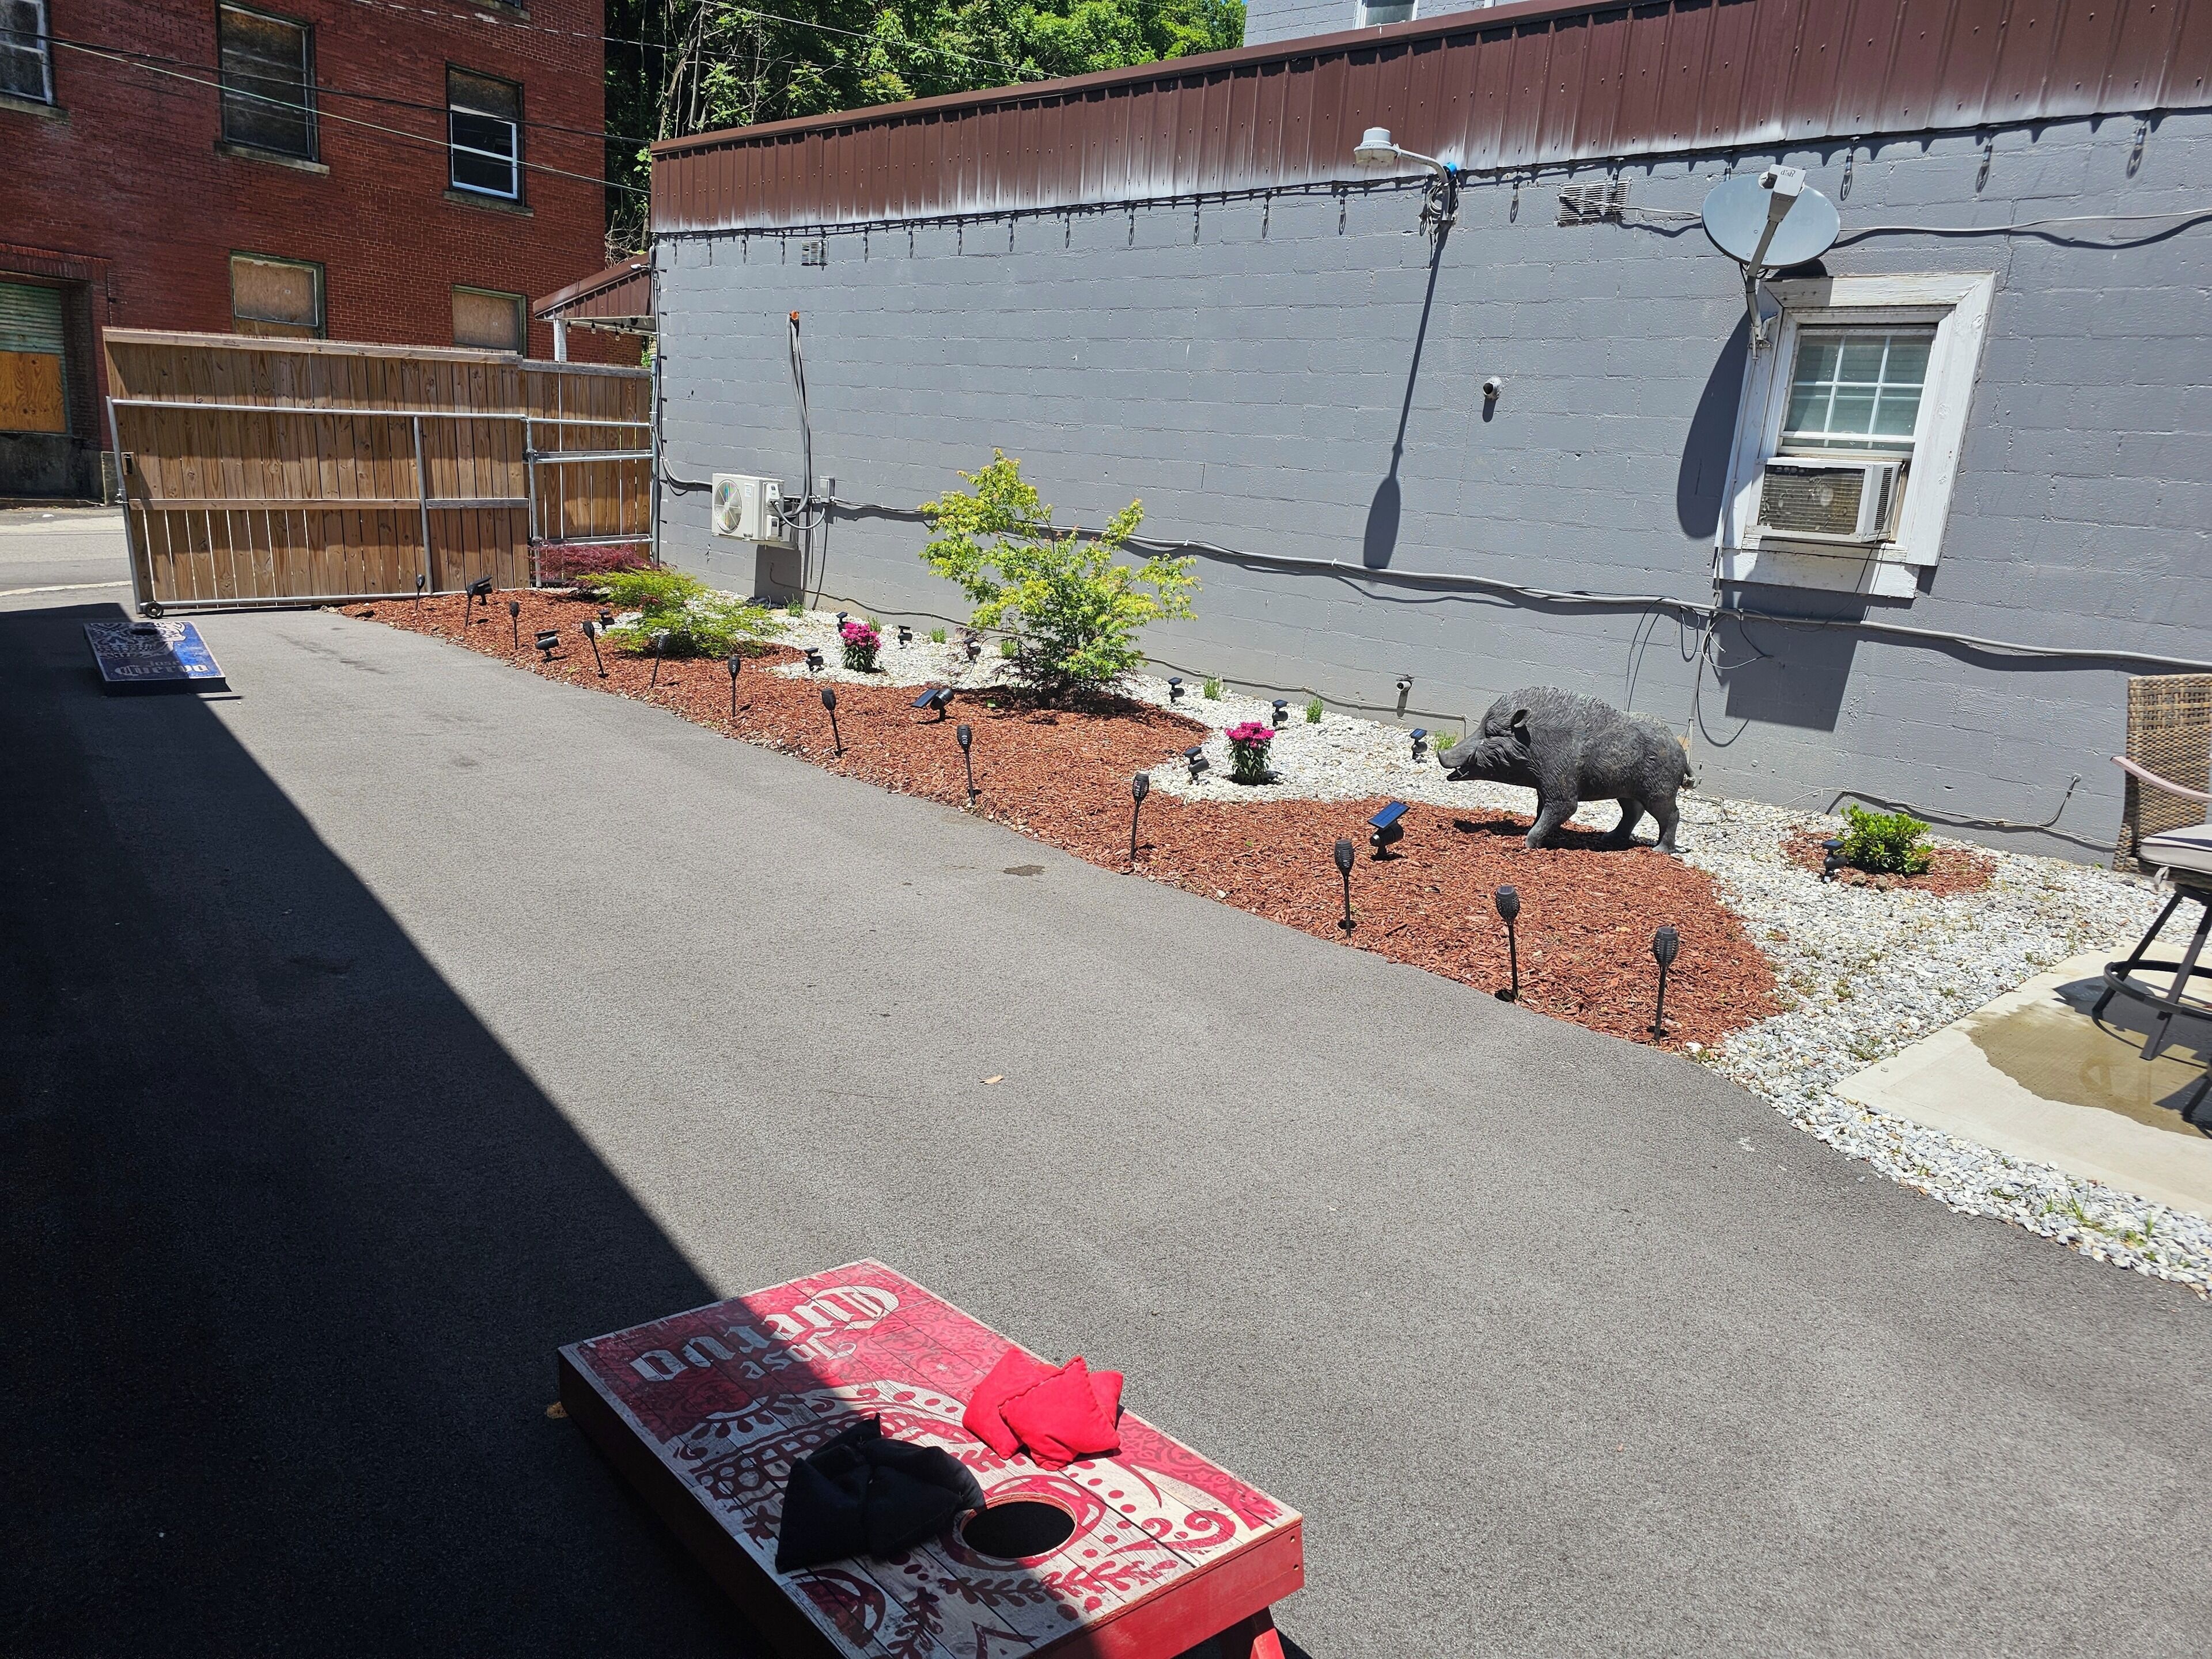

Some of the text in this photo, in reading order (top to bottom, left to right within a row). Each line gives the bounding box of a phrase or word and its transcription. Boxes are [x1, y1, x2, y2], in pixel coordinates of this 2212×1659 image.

[115, 664, 209, 676] Cuervo
[630, 1286, 900, 1381] Cuervo
[739, 1328, 857, 1379] Jose
